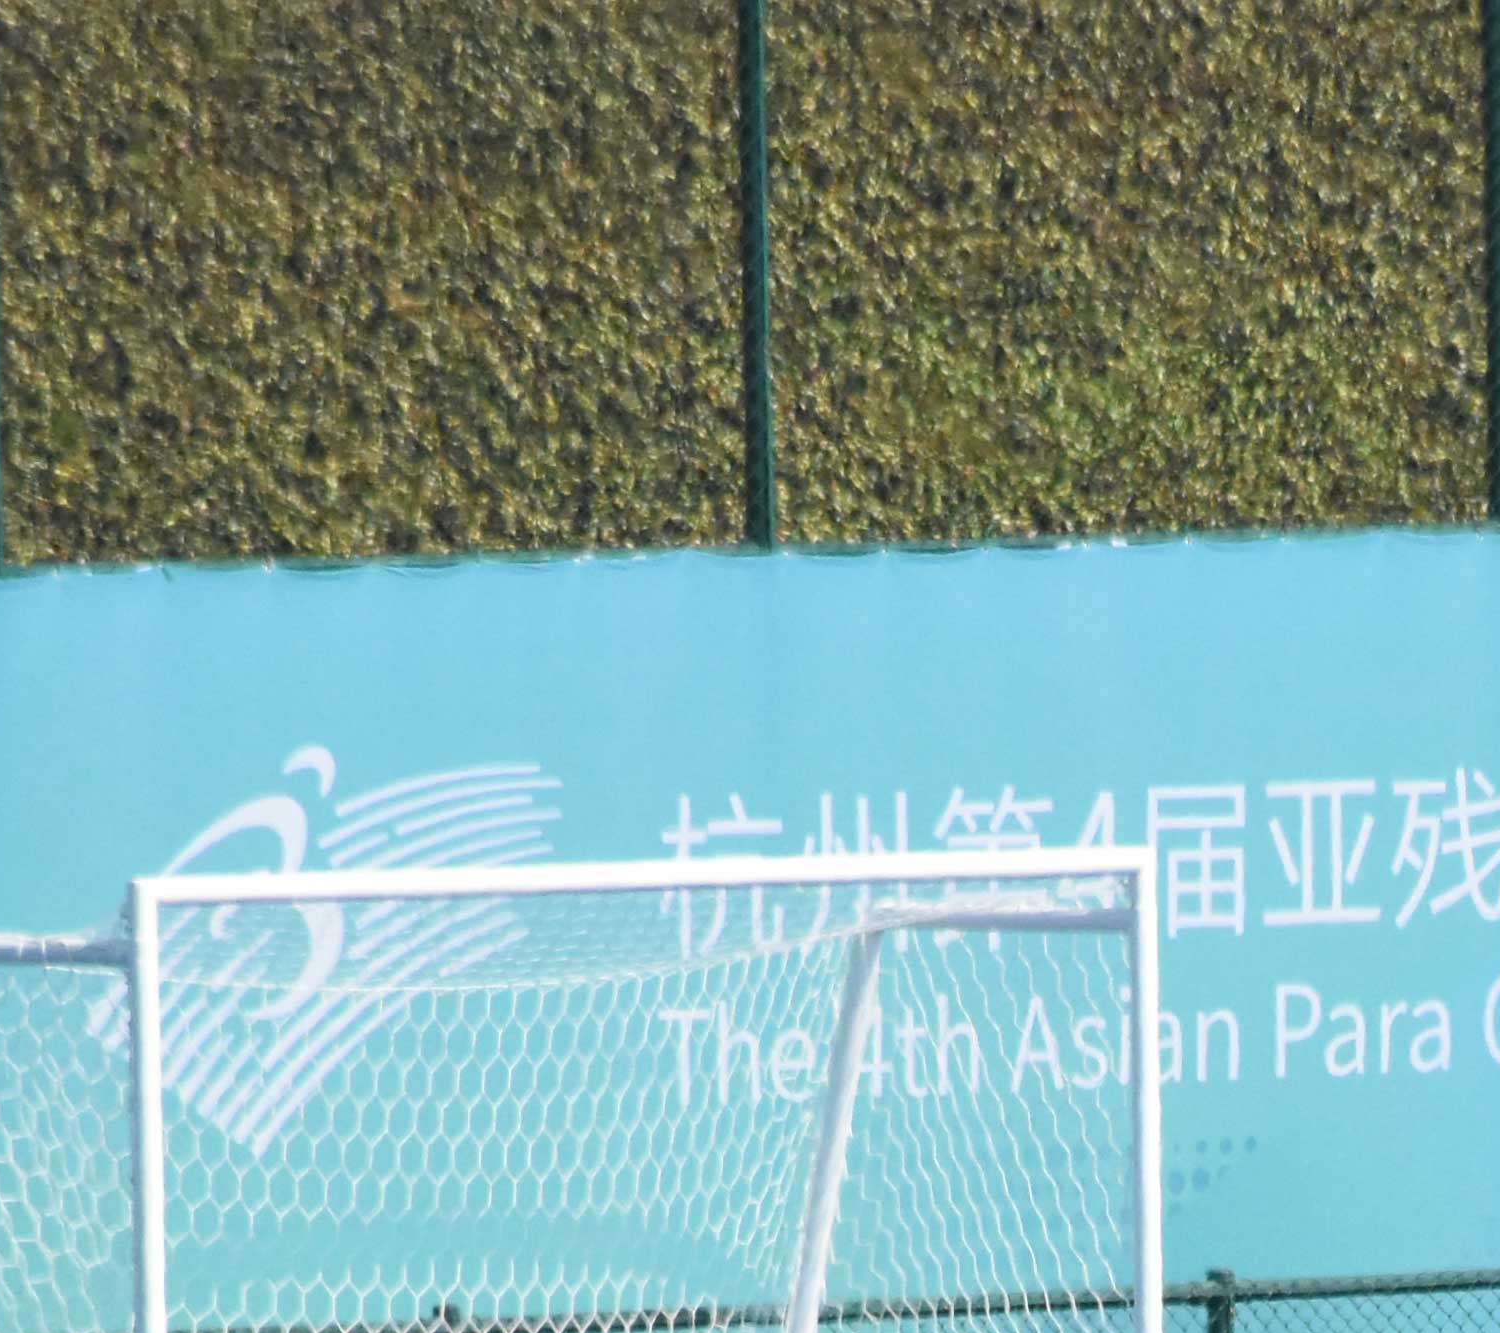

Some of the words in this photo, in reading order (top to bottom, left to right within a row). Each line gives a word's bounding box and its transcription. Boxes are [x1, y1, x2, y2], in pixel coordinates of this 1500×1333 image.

[658, 1000, 817, 1107] The
[854, 993, 981, 1100] 4th
[1011, 984, 1240, 1094] Asian
[1274, 982, 1452, 1079] Para
